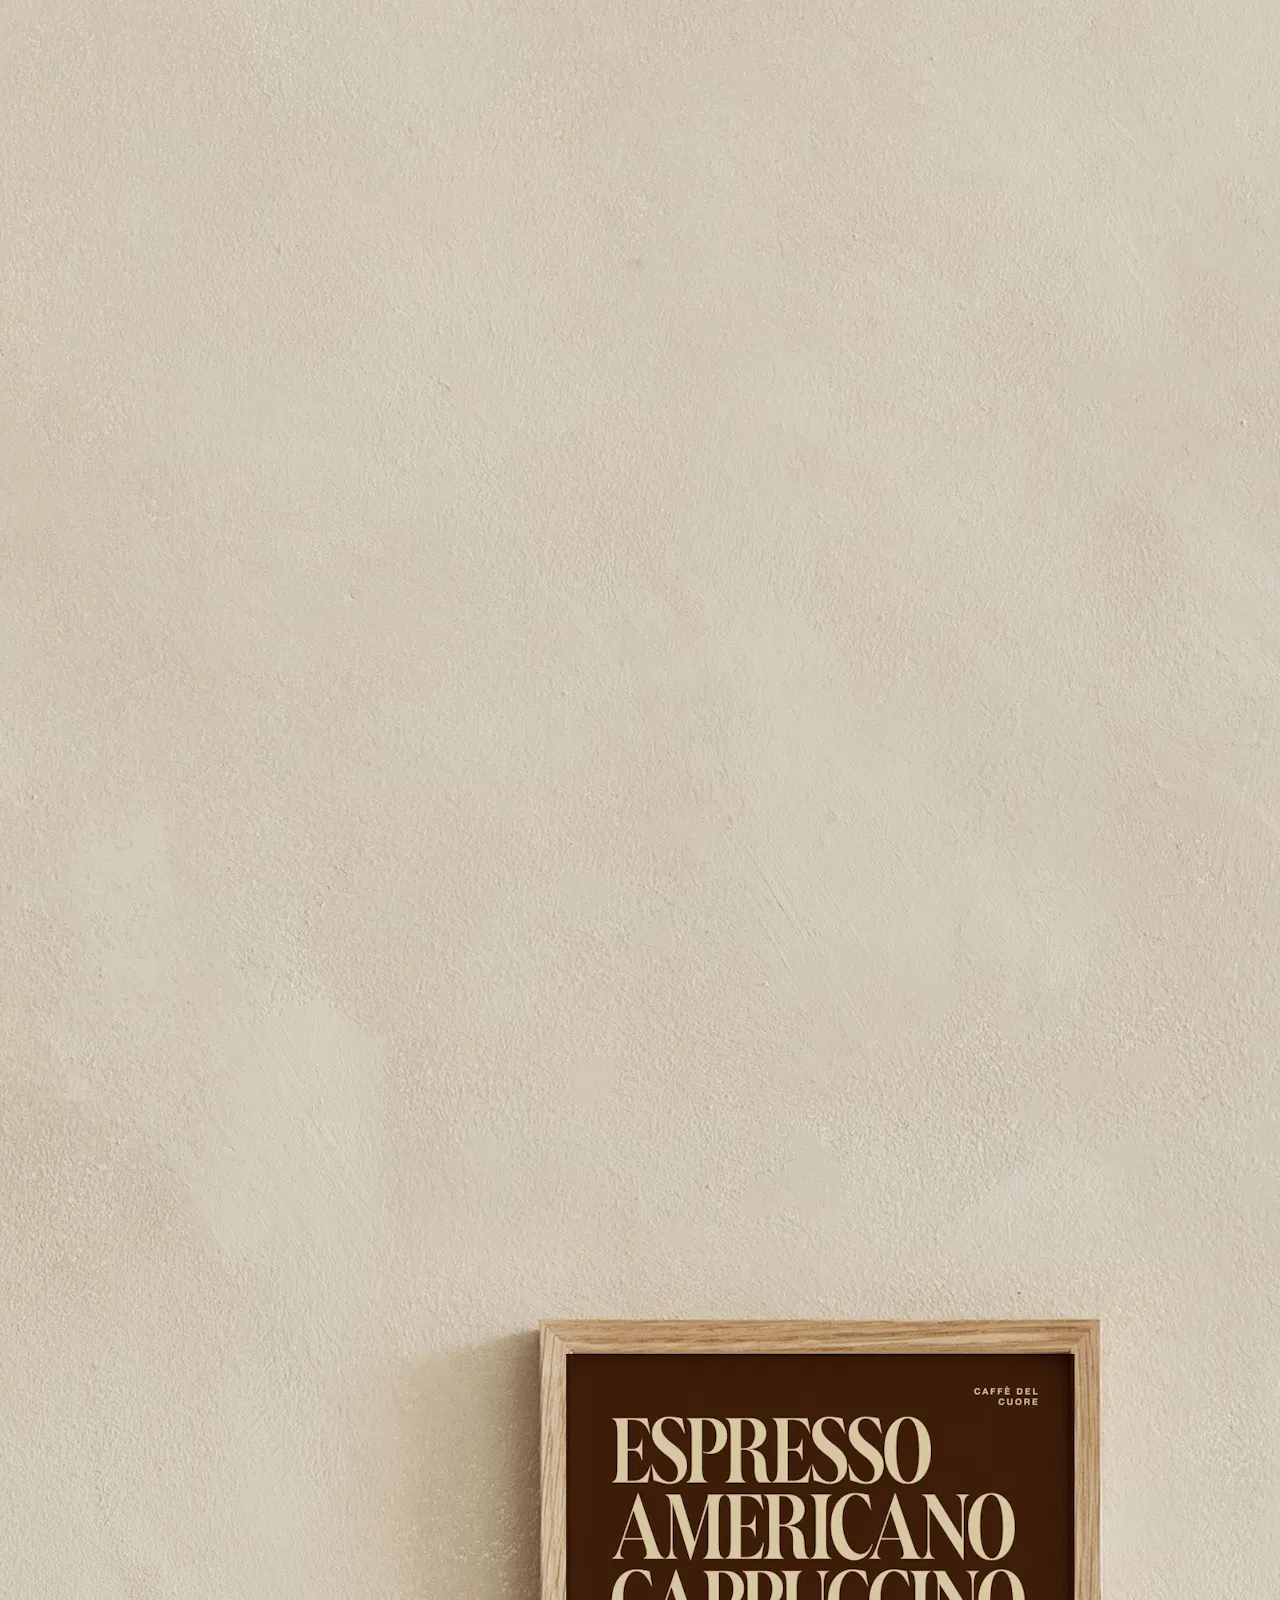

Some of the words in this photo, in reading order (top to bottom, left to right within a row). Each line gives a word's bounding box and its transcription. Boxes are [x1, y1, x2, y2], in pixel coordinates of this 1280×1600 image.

[973, 1386, 1011, 1396] CAFFÈ
[1016, 1387, 1039, 1396] DEL
[997, 1397, 1039, 1406] CUORE
[611, 1416, 932, 1485] ESPRESSO
[611, 1492, 1016, 1561] AMERICANO
